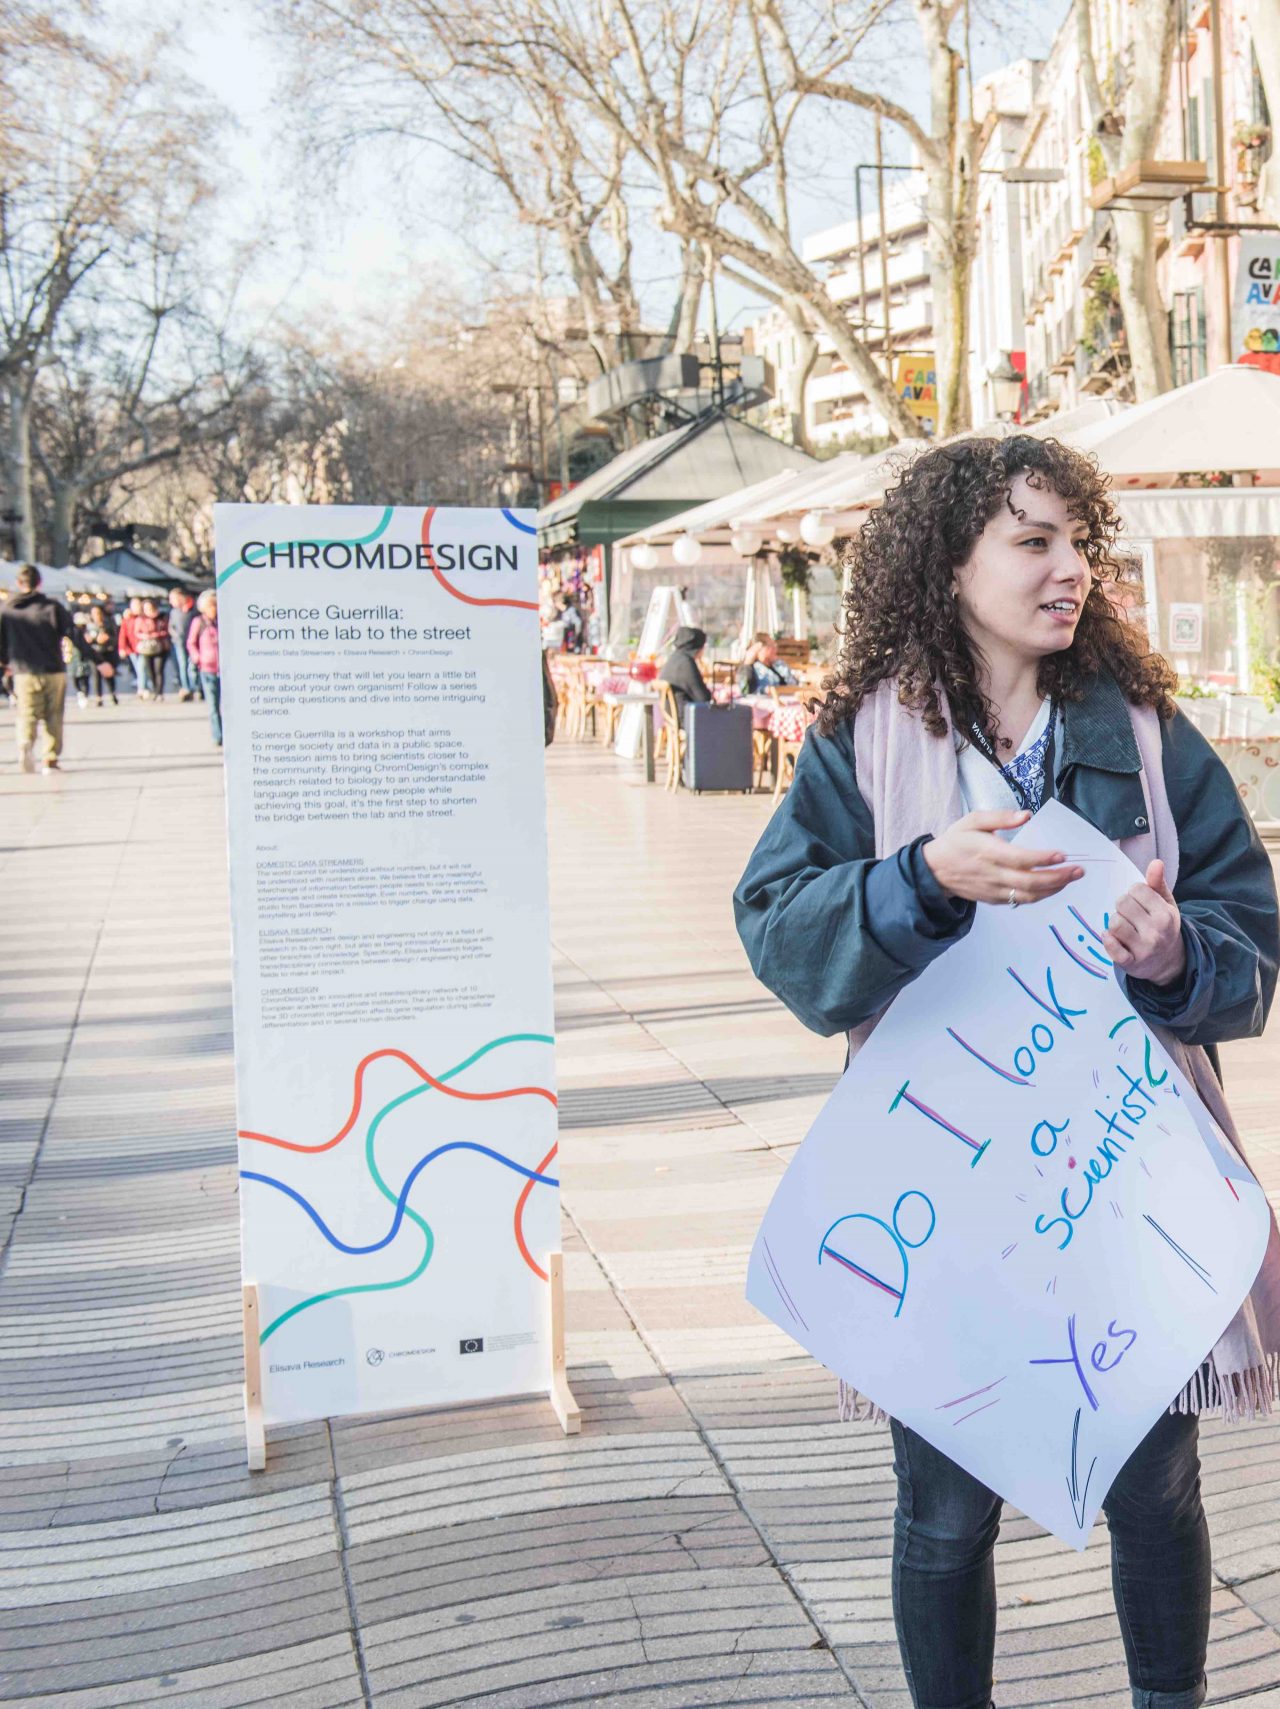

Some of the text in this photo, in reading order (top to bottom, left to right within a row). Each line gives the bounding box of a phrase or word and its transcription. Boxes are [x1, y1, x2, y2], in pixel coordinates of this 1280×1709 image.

[240, 541, 518, 571] CHROMDESIGN
[247, 605, 403, 620] Science Guerrilla:
[249, 625, 471, 640] From the lab to the street
[250, 671, 270, 680] Join
[273, 671, 291, 679] this
[294, 673, 330, 681] journey
[333, 671, 351, 679] that
[355, 671, 370, 679] will
[373, 671, 384, 679] let
[408, 670, 431, 679] learn
[443, 670, 462, 678] little
[465, 670, 476, 678] bit
[279, 683, 306, 691] about
[310, 685, 331, 693] your
[407, 682, 438, 690] Follow
[450, 682, 477, 690] series
[250, 695, 260, 703] of
[263, 695, 295, 705] simple
[299, 694, 346, 704] questions
[349, 694, 367, 702] and
[370, 694, 390, 702] dive
[393, 694, 411, 702] into
[442, 693, 486, 703] intriguing
[252, 730, 291, 738] Science
[294, 730, 335, 738] Guerrilla
[338, 729, 346, 738] is
[358, 729, 405, 739] workshop
[408, 729, 426, 737] that
[429, 728, 451, 737] aims
[971, 721, 993, 755] ELISAVA
[252, 742, 262, 750] to
[265, 744, 296, 752] merge
[299, 741, 333, 751] society
[337, 741, 355, 749] and
[358, 741, 379, 749] data
[382, 741, 391, 749] in
[402, 740, 431, 750] public
[254, 750, 469, 762] The session aims to bring scientists closer to
[253, 765, 269, 773] the
[331, 764, 372, 774] Bringing
[449, 762, 489, 772] complex
[253, 777, 296, 786] research
[299, 776, 332, 785] related
[335, 776, 345, 784] to
[348, 775, 382, 786] biology
[386, 775, 395, 783] to
[412, 773, 486, 782] understandable
[254, 789, 299, 799] language
[302, 788, 321, 796] and
[324, 787, 367, 798] including
[393, 786, 425, 796] people
[428, 785, 452, 794] while
[254, 800, 301, 810] achieving
[304, 799, 322, 808] this
[368, 798, 383, 806] the
[386, 798, 403, 806] first
[406, 797, 427, 807] step
[429, 797, 439, 805] to
[442, 796, 477, 804] shorten
[255, 813, 270, 821] the
[273, 812, 305, 822] bridge
[308, 811, 349, 820] between
[353, 810, 368, 819] the
[371, 810, 385, 818] lab
[388, 809, 406, 818] and
[409, 809, 424, 817] the
[818, 1190, 936, 1317] Do
[888, 1080, 991, 1168] I
[946, 966, 1087, 1086] look
[1031, 1118, 1070, 1157] a
[269, 1357, 345, 1374] Elisava Research
[1029, 1313, 1137, 1411] Yes
